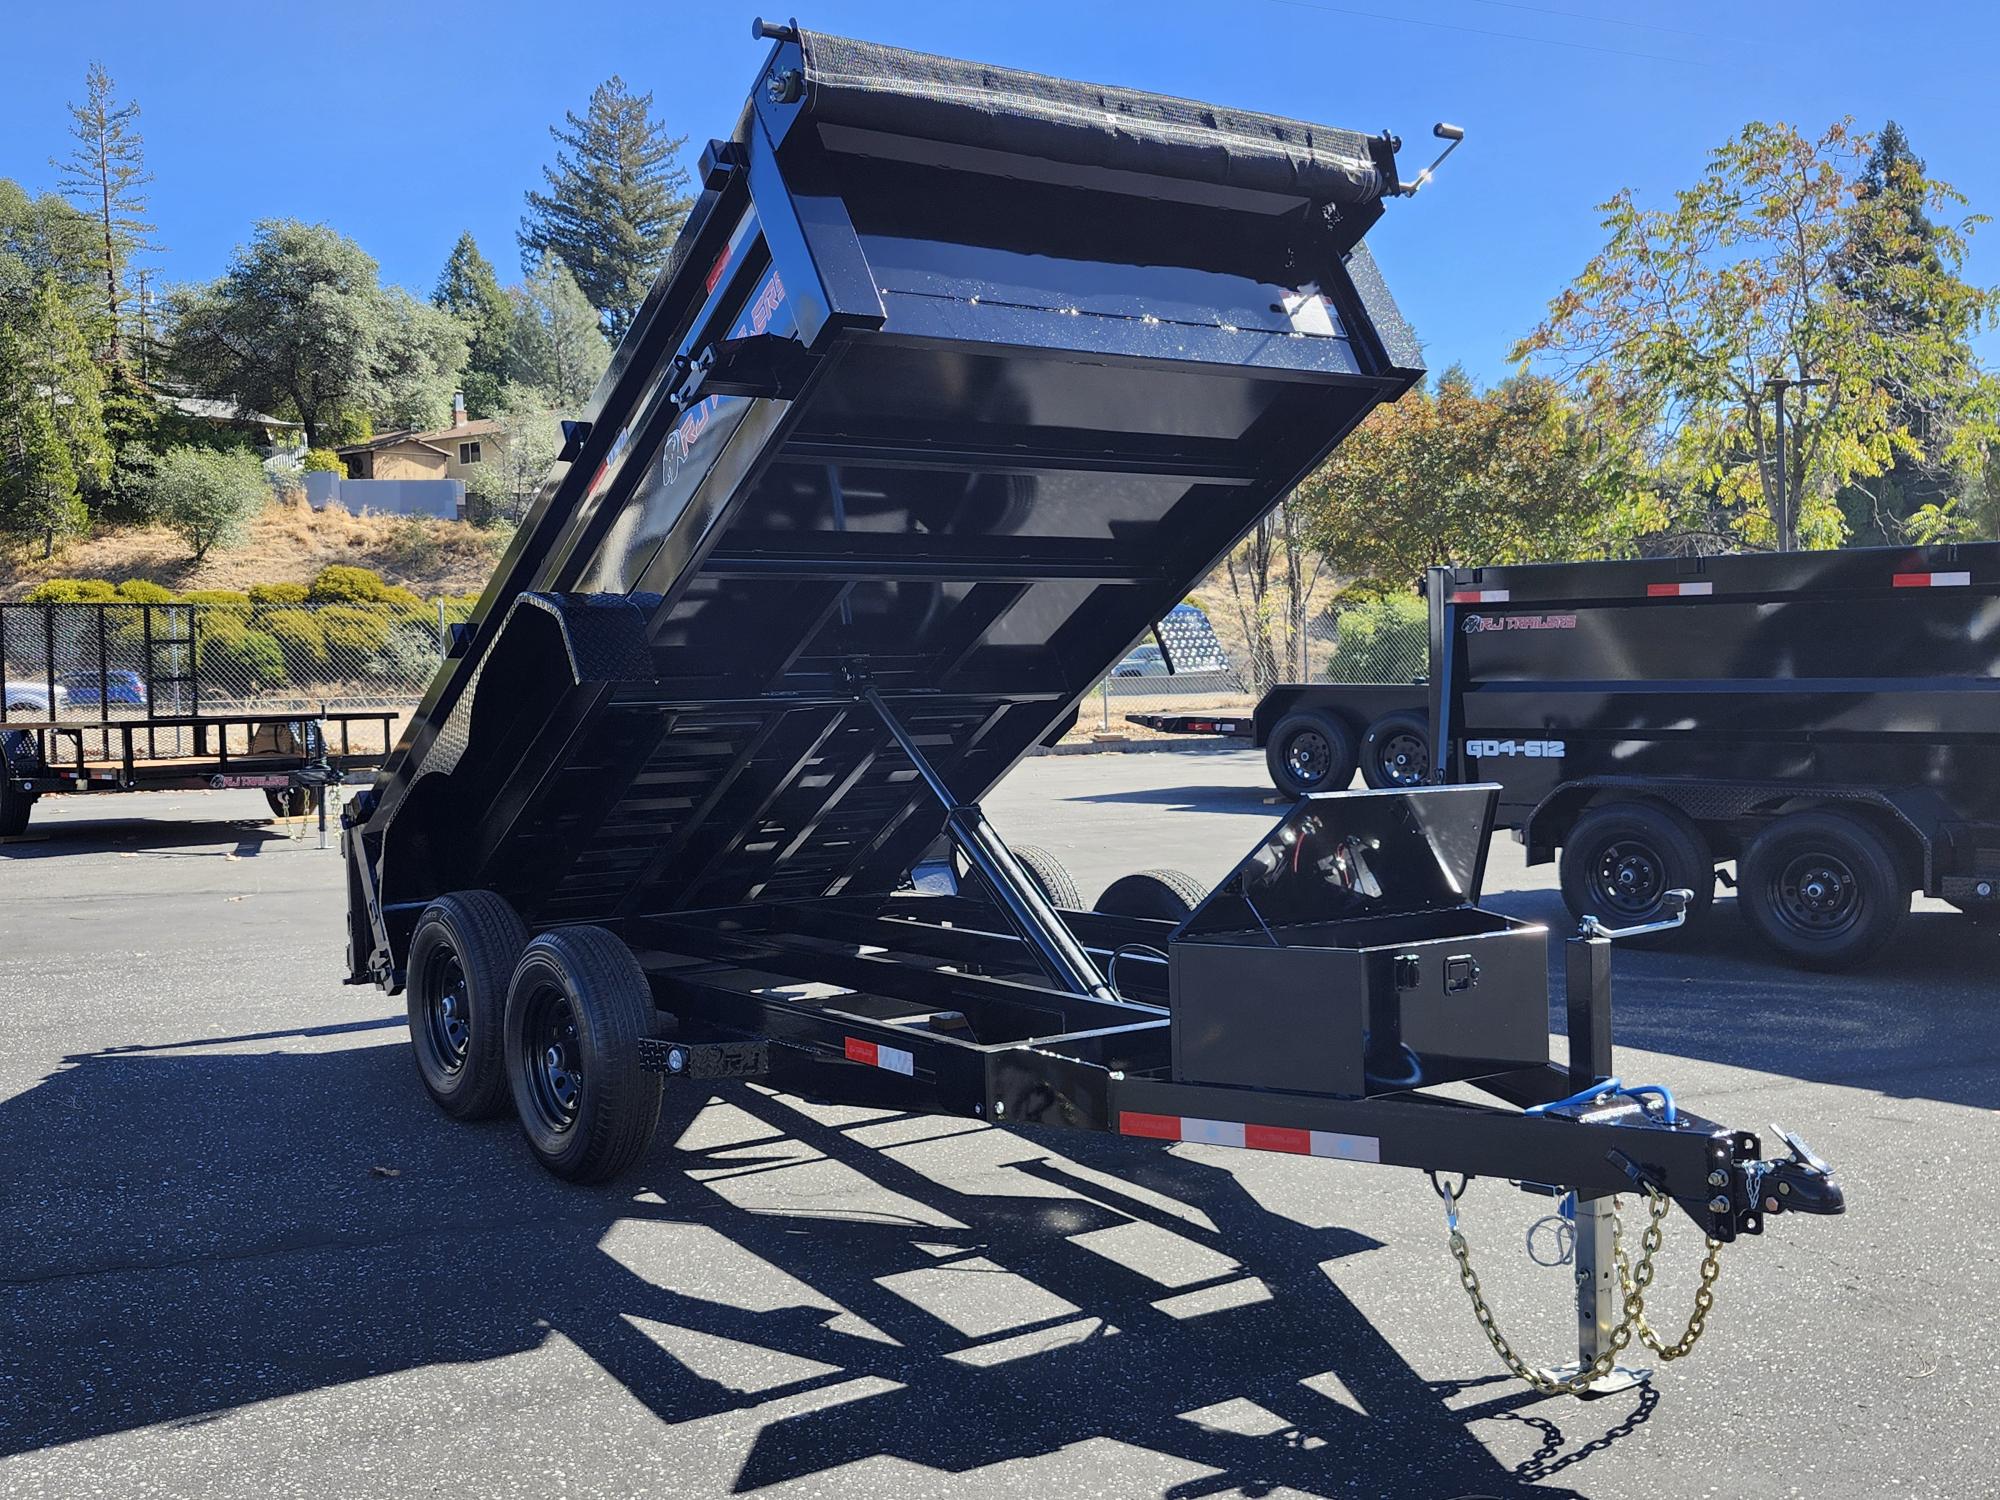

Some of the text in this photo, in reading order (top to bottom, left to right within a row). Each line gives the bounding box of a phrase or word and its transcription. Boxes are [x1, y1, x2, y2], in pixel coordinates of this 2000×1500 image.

[680, 399, 709, 458] RJ
[1480, 615, 1577, 632] RJ TRAILERS
[1466, 740, 1565, 759] GD4-612
